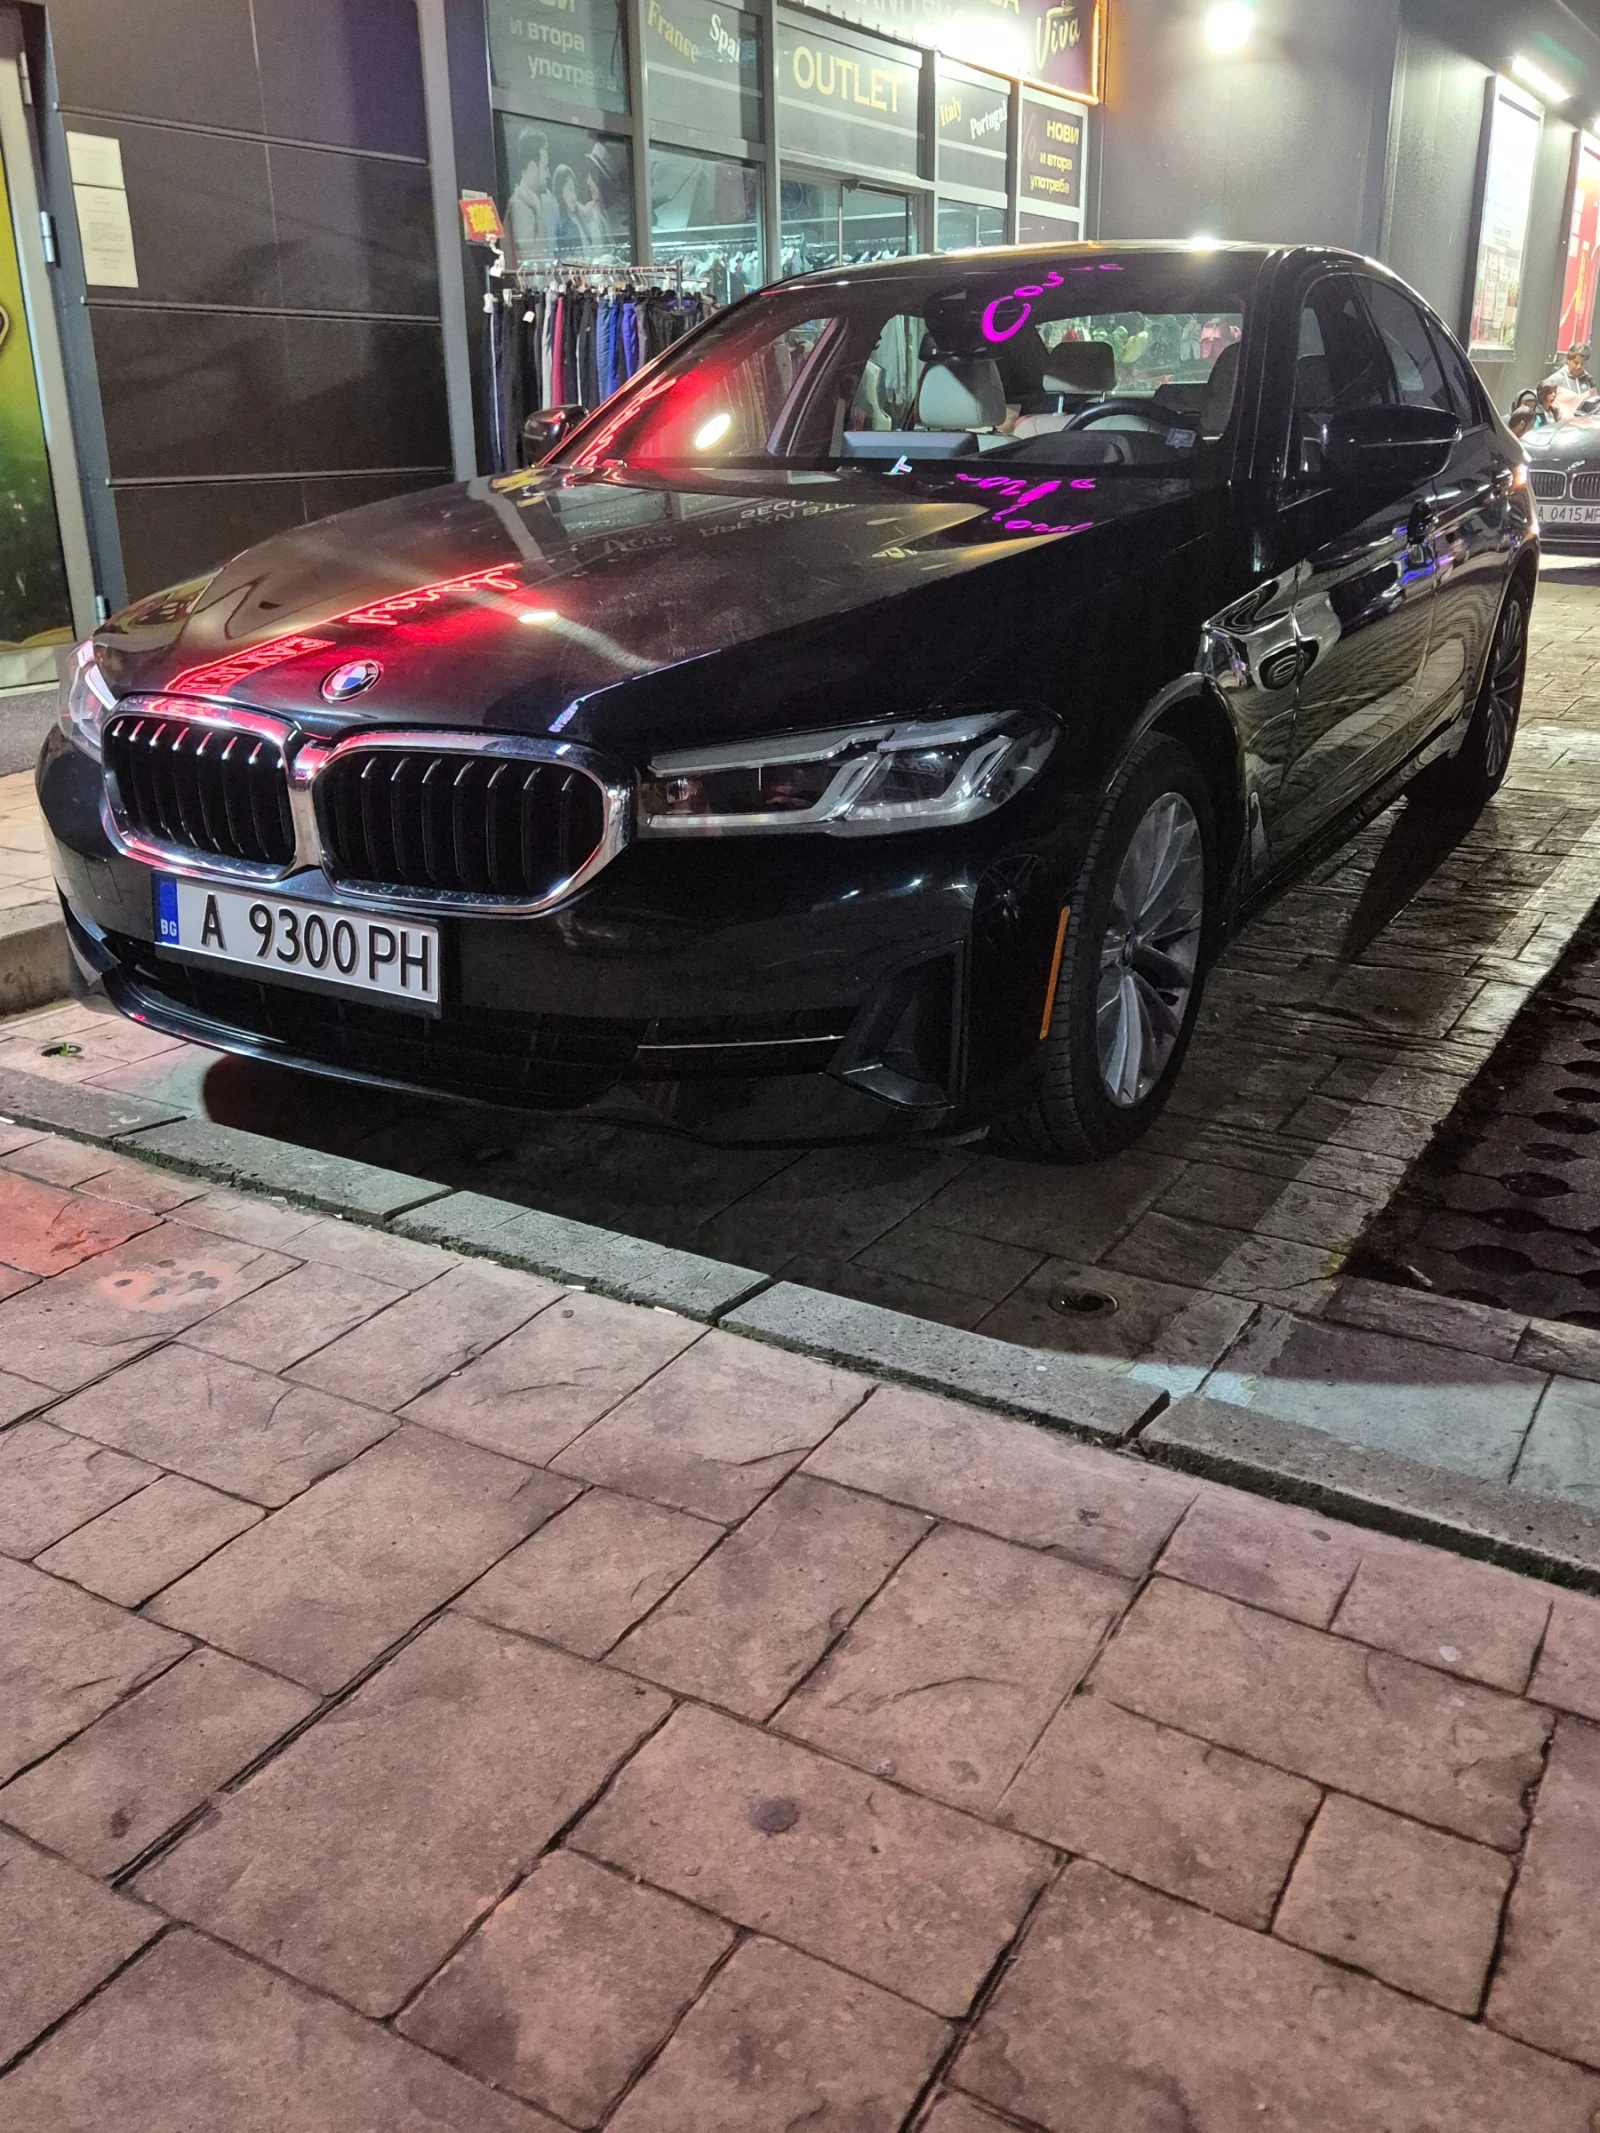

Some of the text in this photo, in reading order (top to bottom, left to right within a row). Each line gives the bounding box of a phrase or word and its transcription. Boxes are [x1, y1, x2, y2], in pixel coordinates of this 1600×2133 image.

[527, 21, 585, 53] втора
[647, 0, 700, 63] France
[709, 13, 743, 64] Spai
[1036, 6, 1081, 69] Viva
[527, 55, 617, 92] употреа
[792, 46, 904, 113] OUTLET
[939, 96, 962, 127] Italy
[969, 99, 1008, 140] Portugal
[1046, 120, 1080, 145] НОВИ
[1047, 153, 1073, 173] втора
[1030, 175, 1070, 194] употреба
[1537, 506, 1544, 520] A
[1551, 506, 1583, 521] 0415
[160, 918, 178, 937] BG
[200, 894, 431, 993] A 9300 PH
